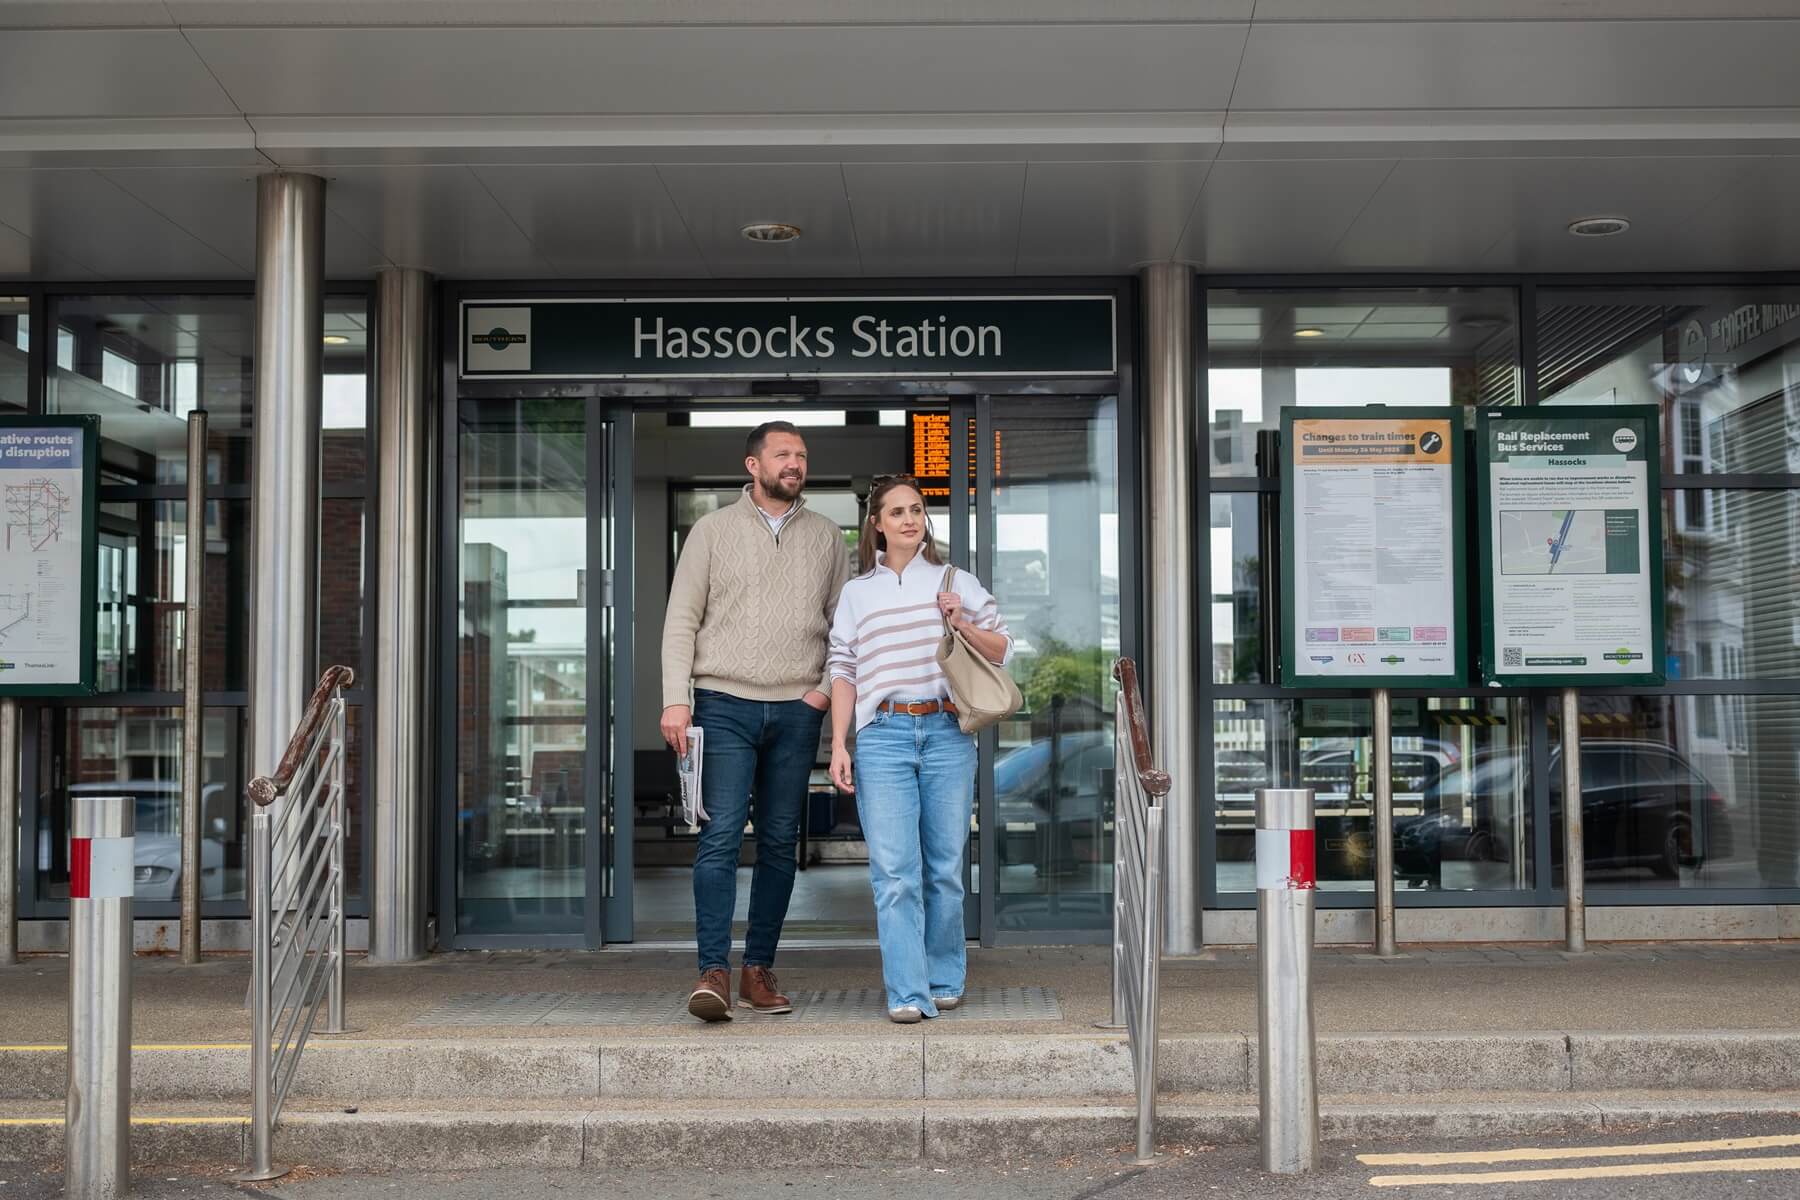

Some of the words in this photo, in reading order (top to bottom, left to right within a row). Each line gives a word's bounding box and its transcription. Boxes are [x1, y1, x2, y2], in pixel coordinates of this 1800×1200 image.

[1721, 304, 1761, 351] COFFEE
[634, 315, 835, 358] Hassocks
[851, 315, 1001, 357] Station
[34, 435, 73, 444] routes
[1302, 432, 1346, 443] Changes
[1348, 433, 1358, 441] to
[1361, 432, 1384, 441] train
[1387, 431, 1415, 441] times
[1498, 432, 1517, 441] Rail
[1520, 432, 1590, 442] Replacement
[1498, 443, 1517, 451] Bus
[1520, 442, 1564, 451] Services
[6, 446, 70, 460] disruption
[1548, 458, 1587, 466] Hassocks
